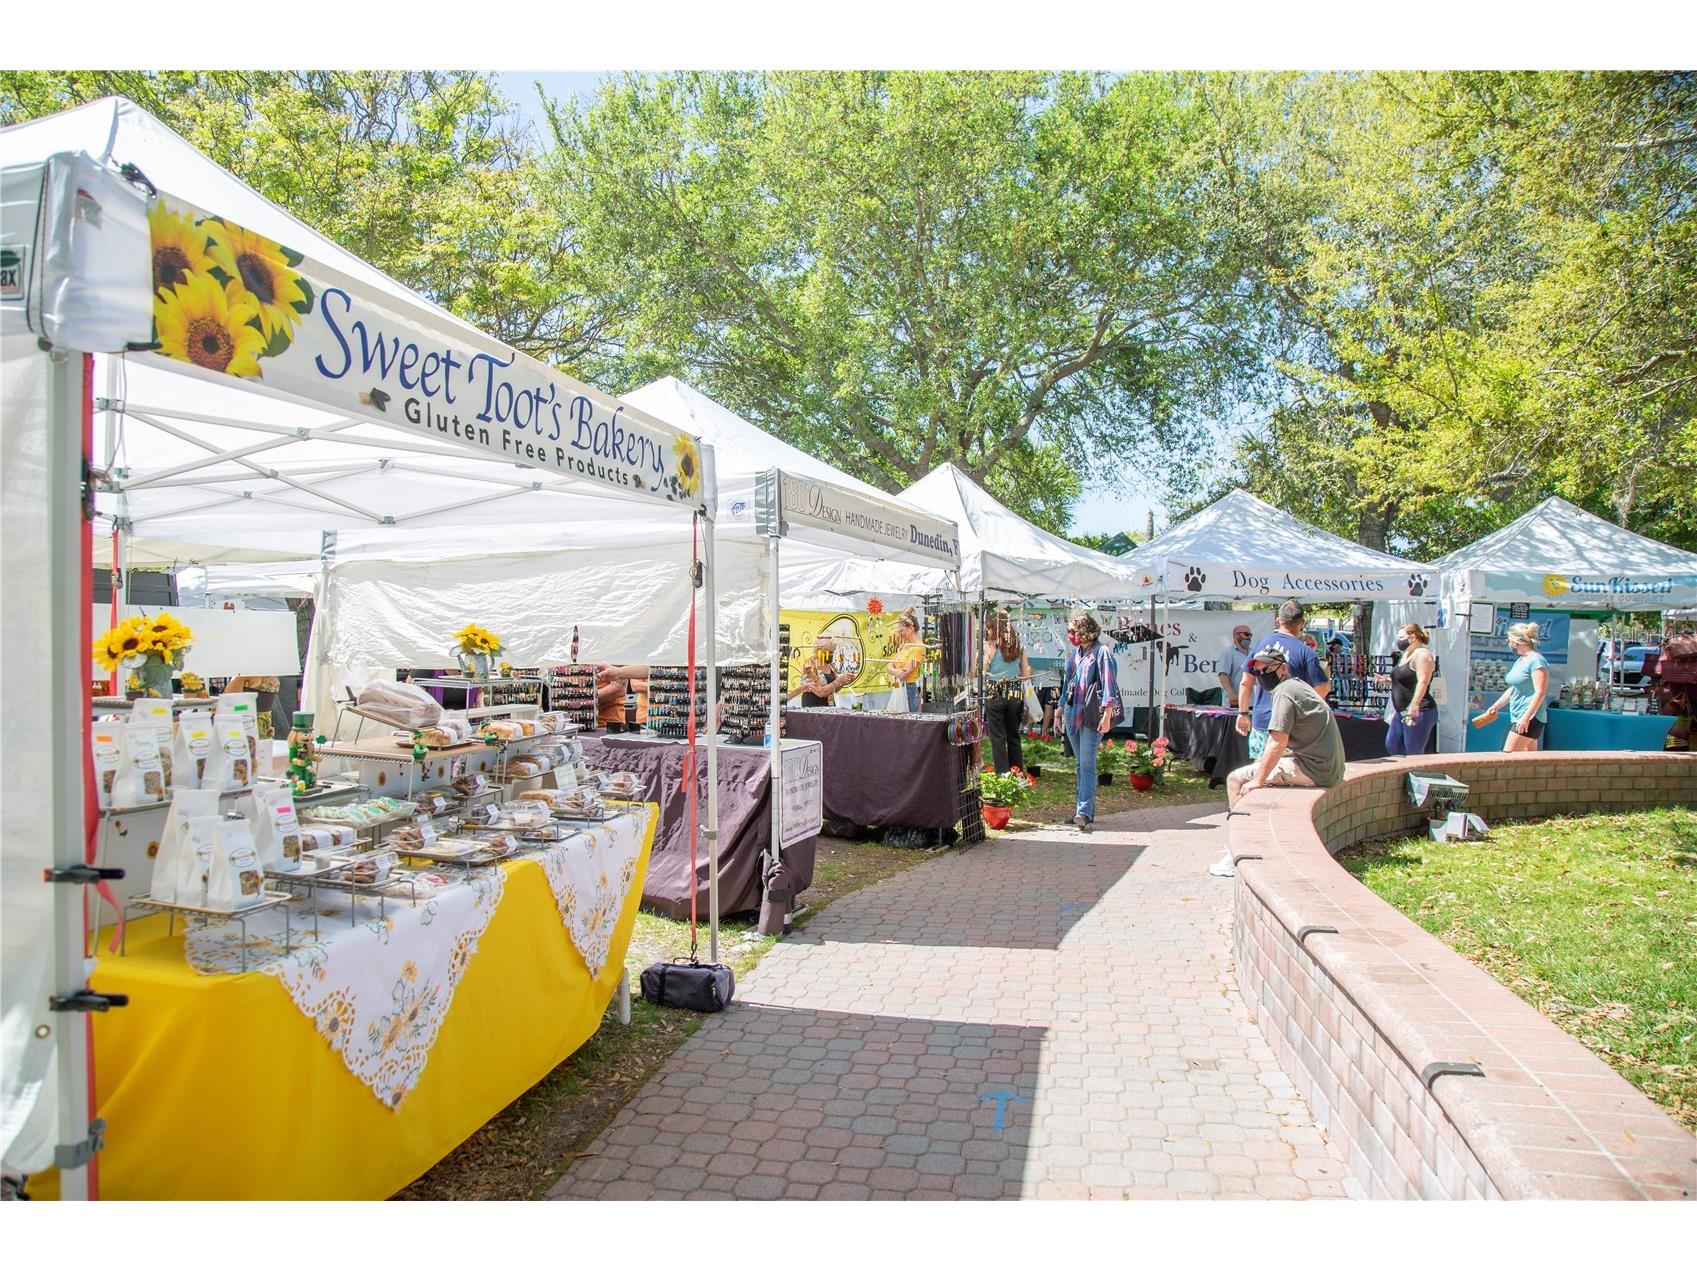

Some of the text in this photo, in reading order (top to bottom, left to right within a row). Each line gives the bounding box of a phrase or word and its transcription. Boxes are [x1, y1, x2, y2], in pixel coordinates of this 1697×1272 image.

[315, 288, 664, 492] Sweet Toot's Bakery
[404, 397, 628, 486] Gluten Free Products
[845, 510, 883, 535] HANDMADE
[883, 523, 910, 541] JEWELRY
[909, 524, 953, 557] Dunedin,
[952, 538, 960, 556] F
[1232, 570, 1384, 595] Dog Accessories
[1188, 632, 1198, 643] &
